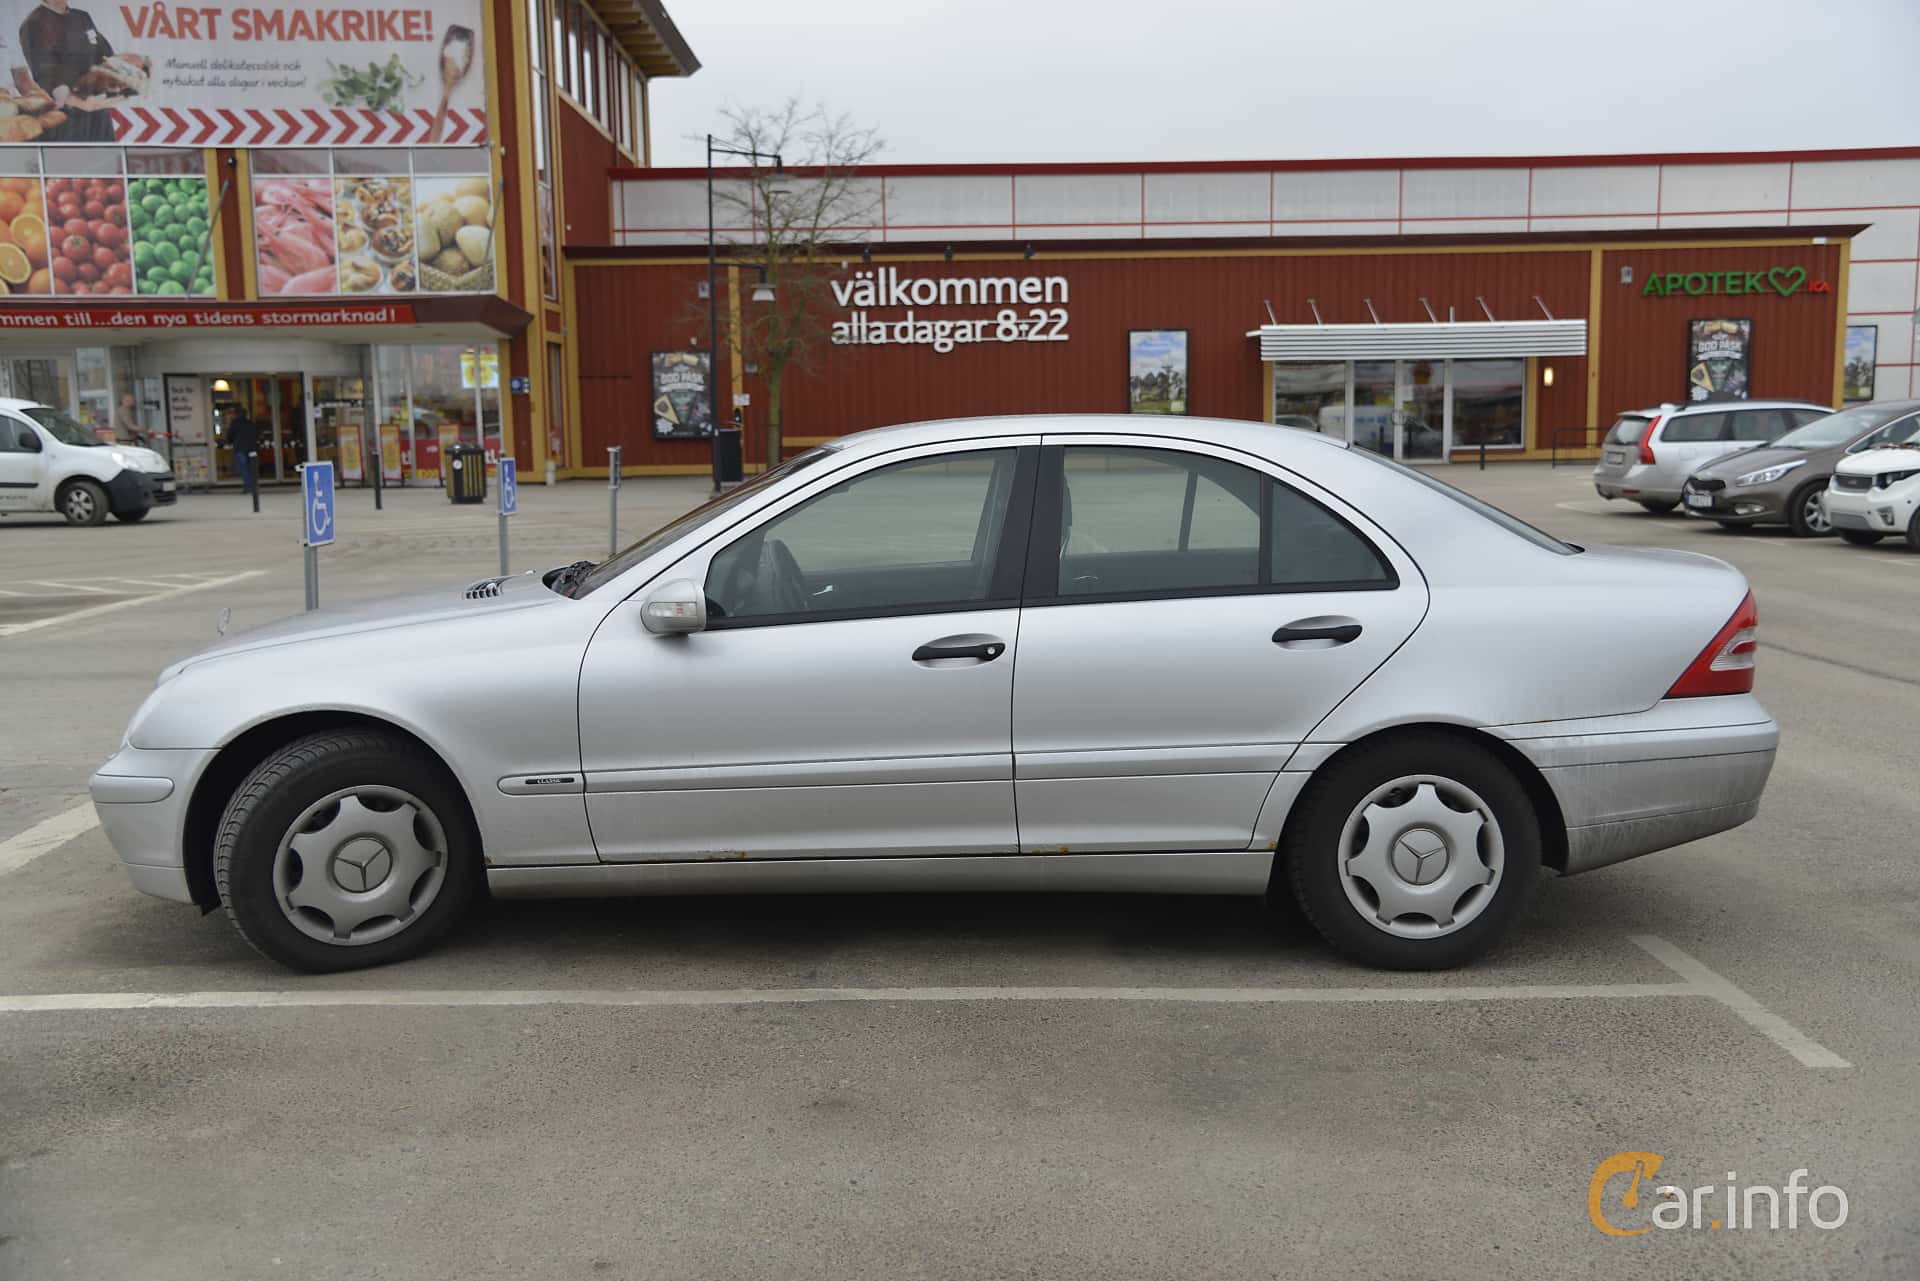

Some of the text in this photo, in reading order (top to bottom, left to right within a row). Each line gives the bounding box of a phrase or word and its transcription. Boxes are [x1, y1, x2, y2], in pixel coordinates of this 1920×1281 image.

[120, 1, 434, 42] VÅRT SMAKRIKE!
[207, 75, 226, 87] alla
[830, 267, 1069, 307] välkommen
[1643, 271, 1764, 297] APOTEK
[153, 315, 188, 328] nya
[193, 311, 255, 325] tidens
[261, 307, 396, 324] stormarknad!
[832, 311, 887, 345] alla
[894, 310, 989, 353] dagar
